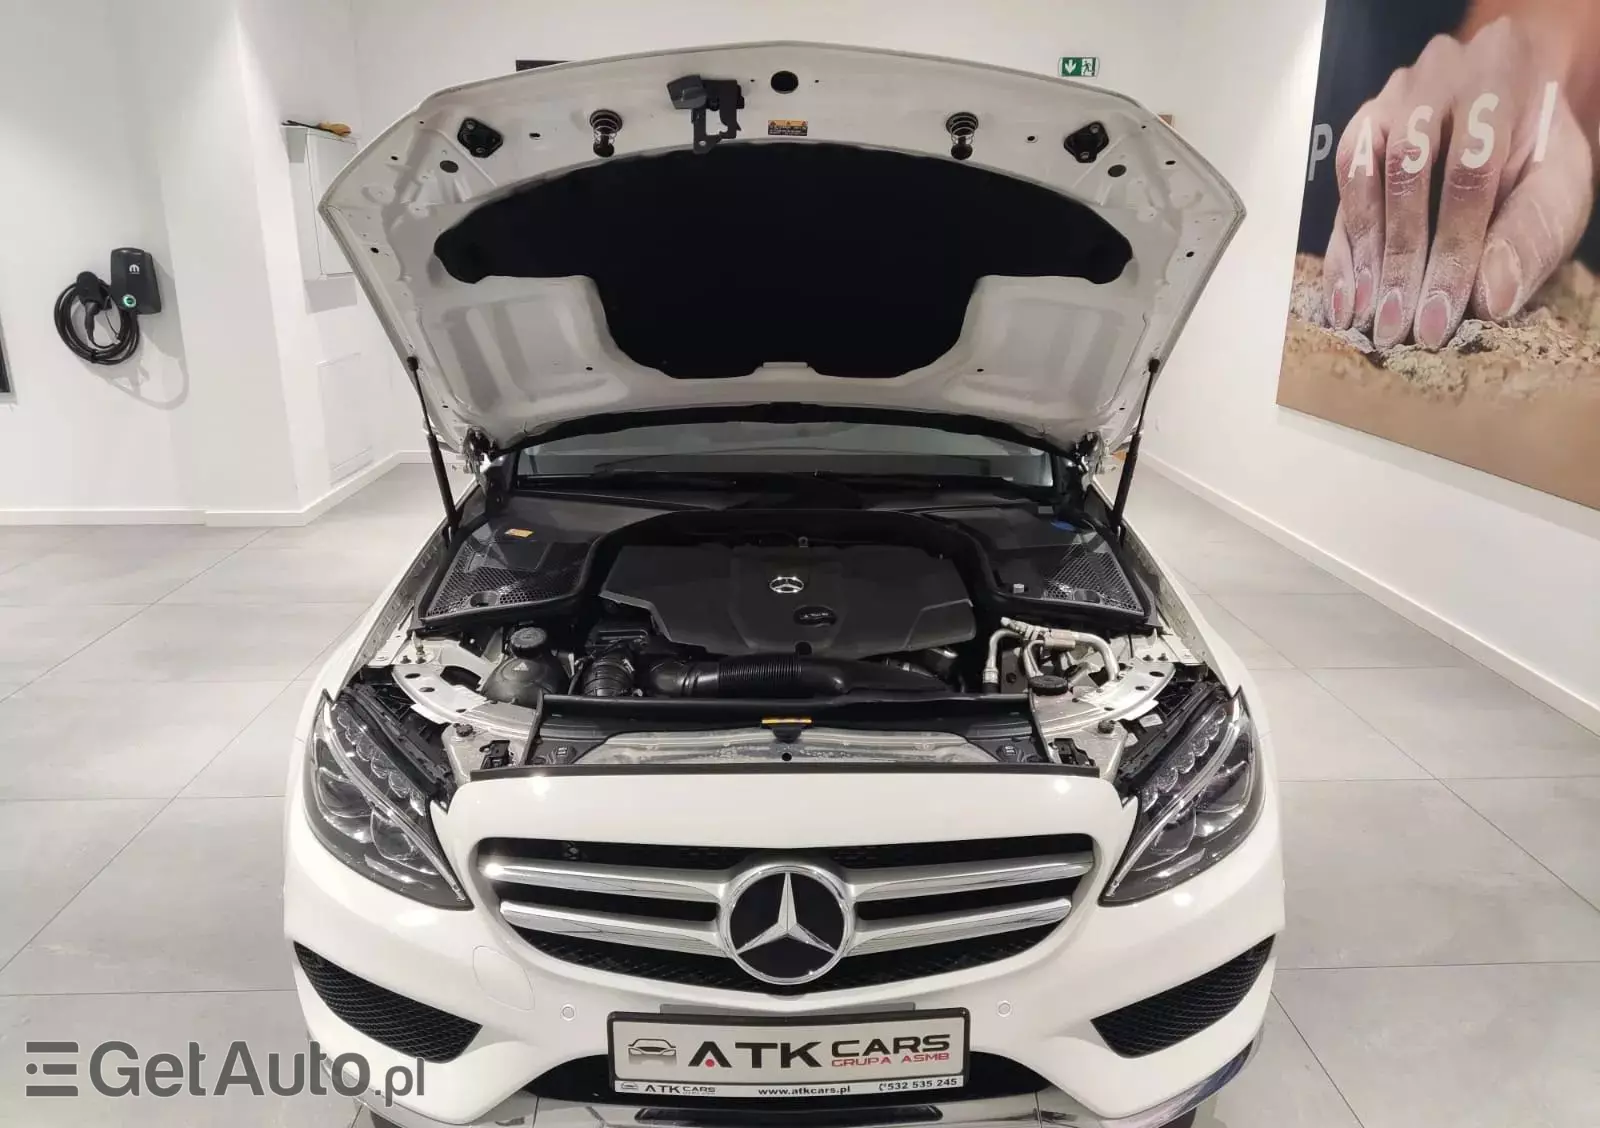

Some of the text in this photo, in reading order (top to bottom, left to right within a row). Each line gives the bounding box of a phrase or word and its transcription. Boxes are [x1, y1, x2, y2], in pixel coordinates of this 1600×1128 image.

[1307, 81, 1600, 182] PASSI
[687, 1033, 951, 1069] ATK CARS
[831, 1052, 950, 1068] GRUPA ASMB
[645, 1083, 716, 1095] ATK CARS
[757, 1085, 851, 1097] www.atkcars.pl
[887, 1077, 957, 1091] 532 535 245
